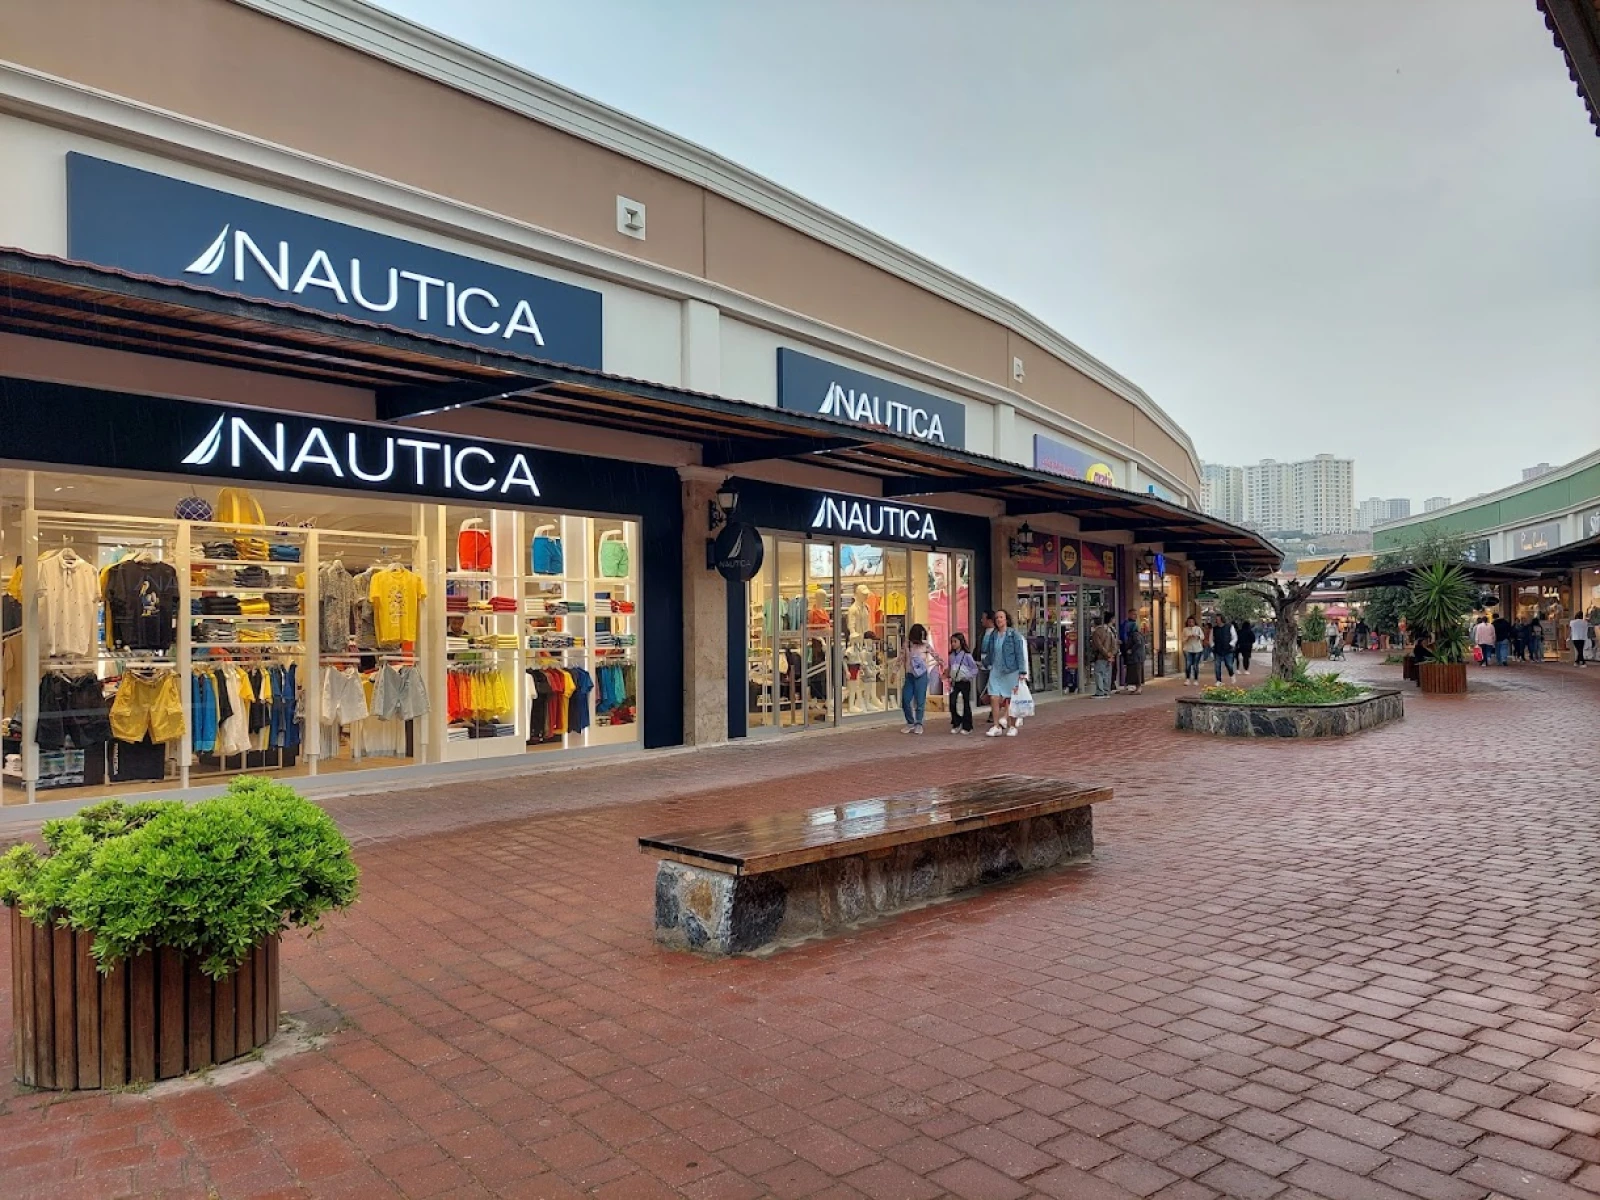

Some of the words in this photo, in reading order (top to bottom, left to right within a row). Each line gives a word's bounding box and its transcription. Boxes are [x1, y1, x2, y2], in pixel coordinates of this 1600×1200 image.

[234, 229, 545, 346] NAUTICA
[833, 384, 945, 443] NAUTICA
[231, 416, 541, 497] NAUTICA
[826, 496, 937, 541] NAUTICA
